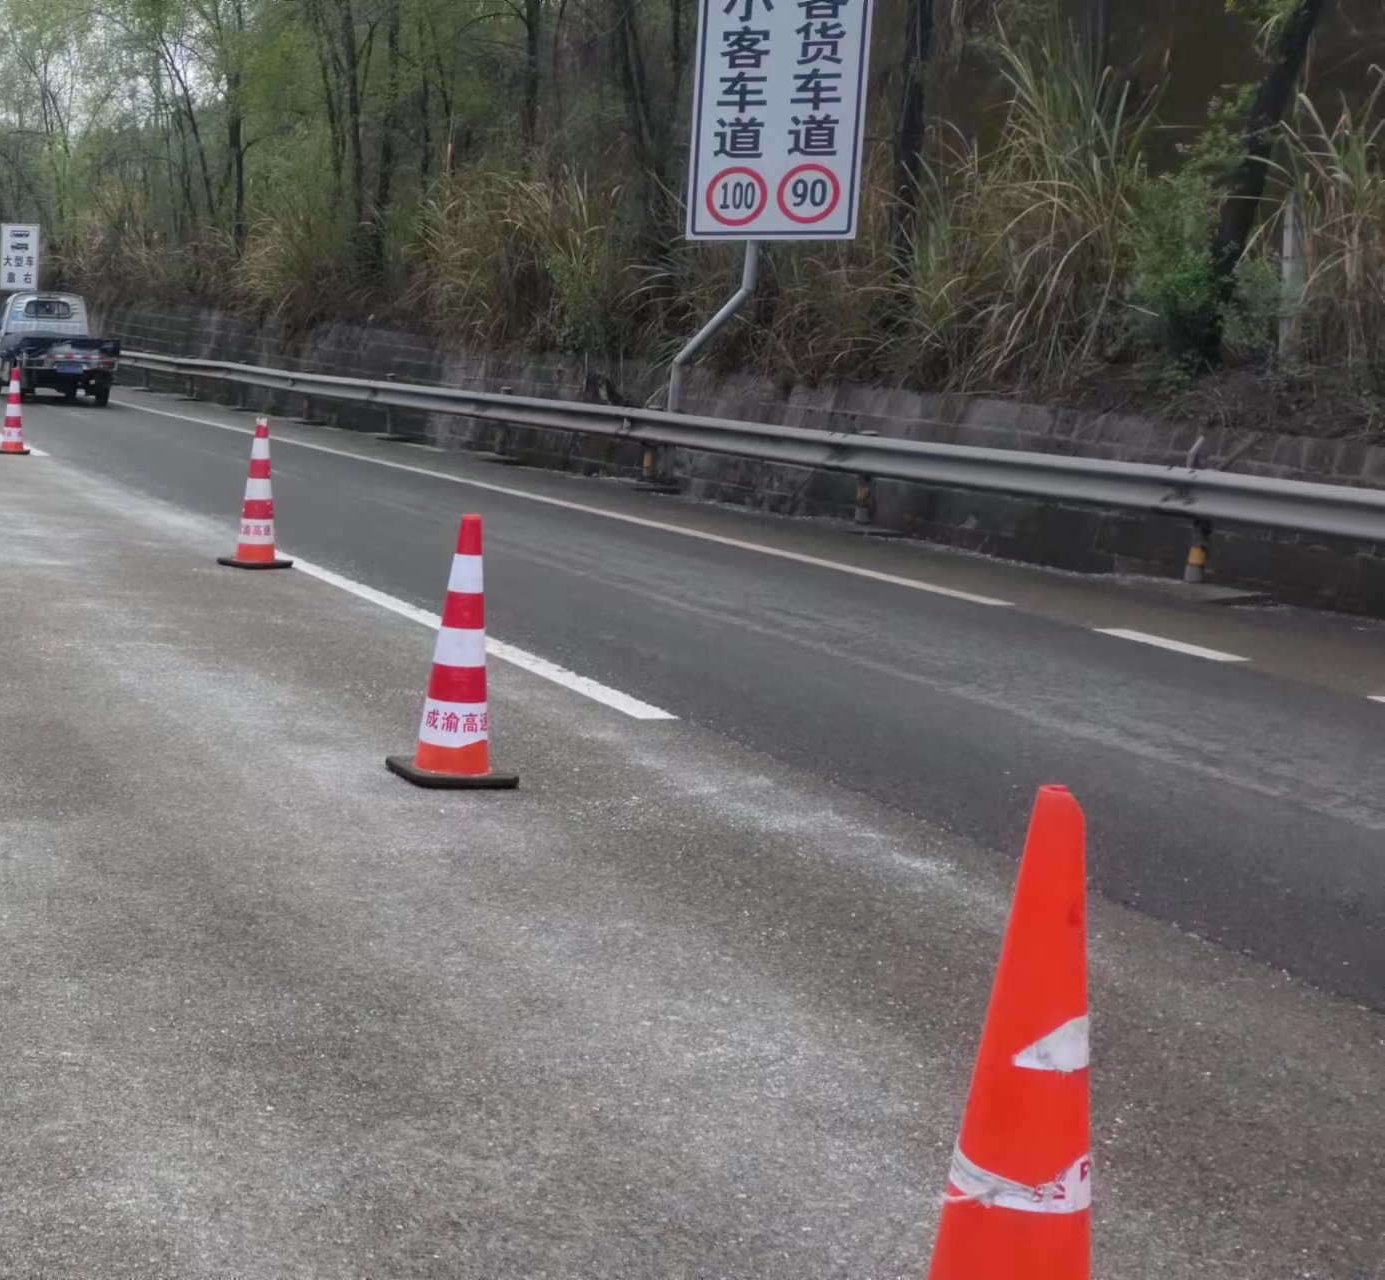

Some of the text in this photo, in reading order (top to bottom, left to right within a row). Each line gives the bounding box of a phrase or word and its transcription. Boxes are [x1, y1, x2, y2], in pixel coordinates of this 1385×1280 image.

[719, 181, 756, 210] 100
[791, 178, 827, 207] 90
[3, 255, 34, 267] 大型车
